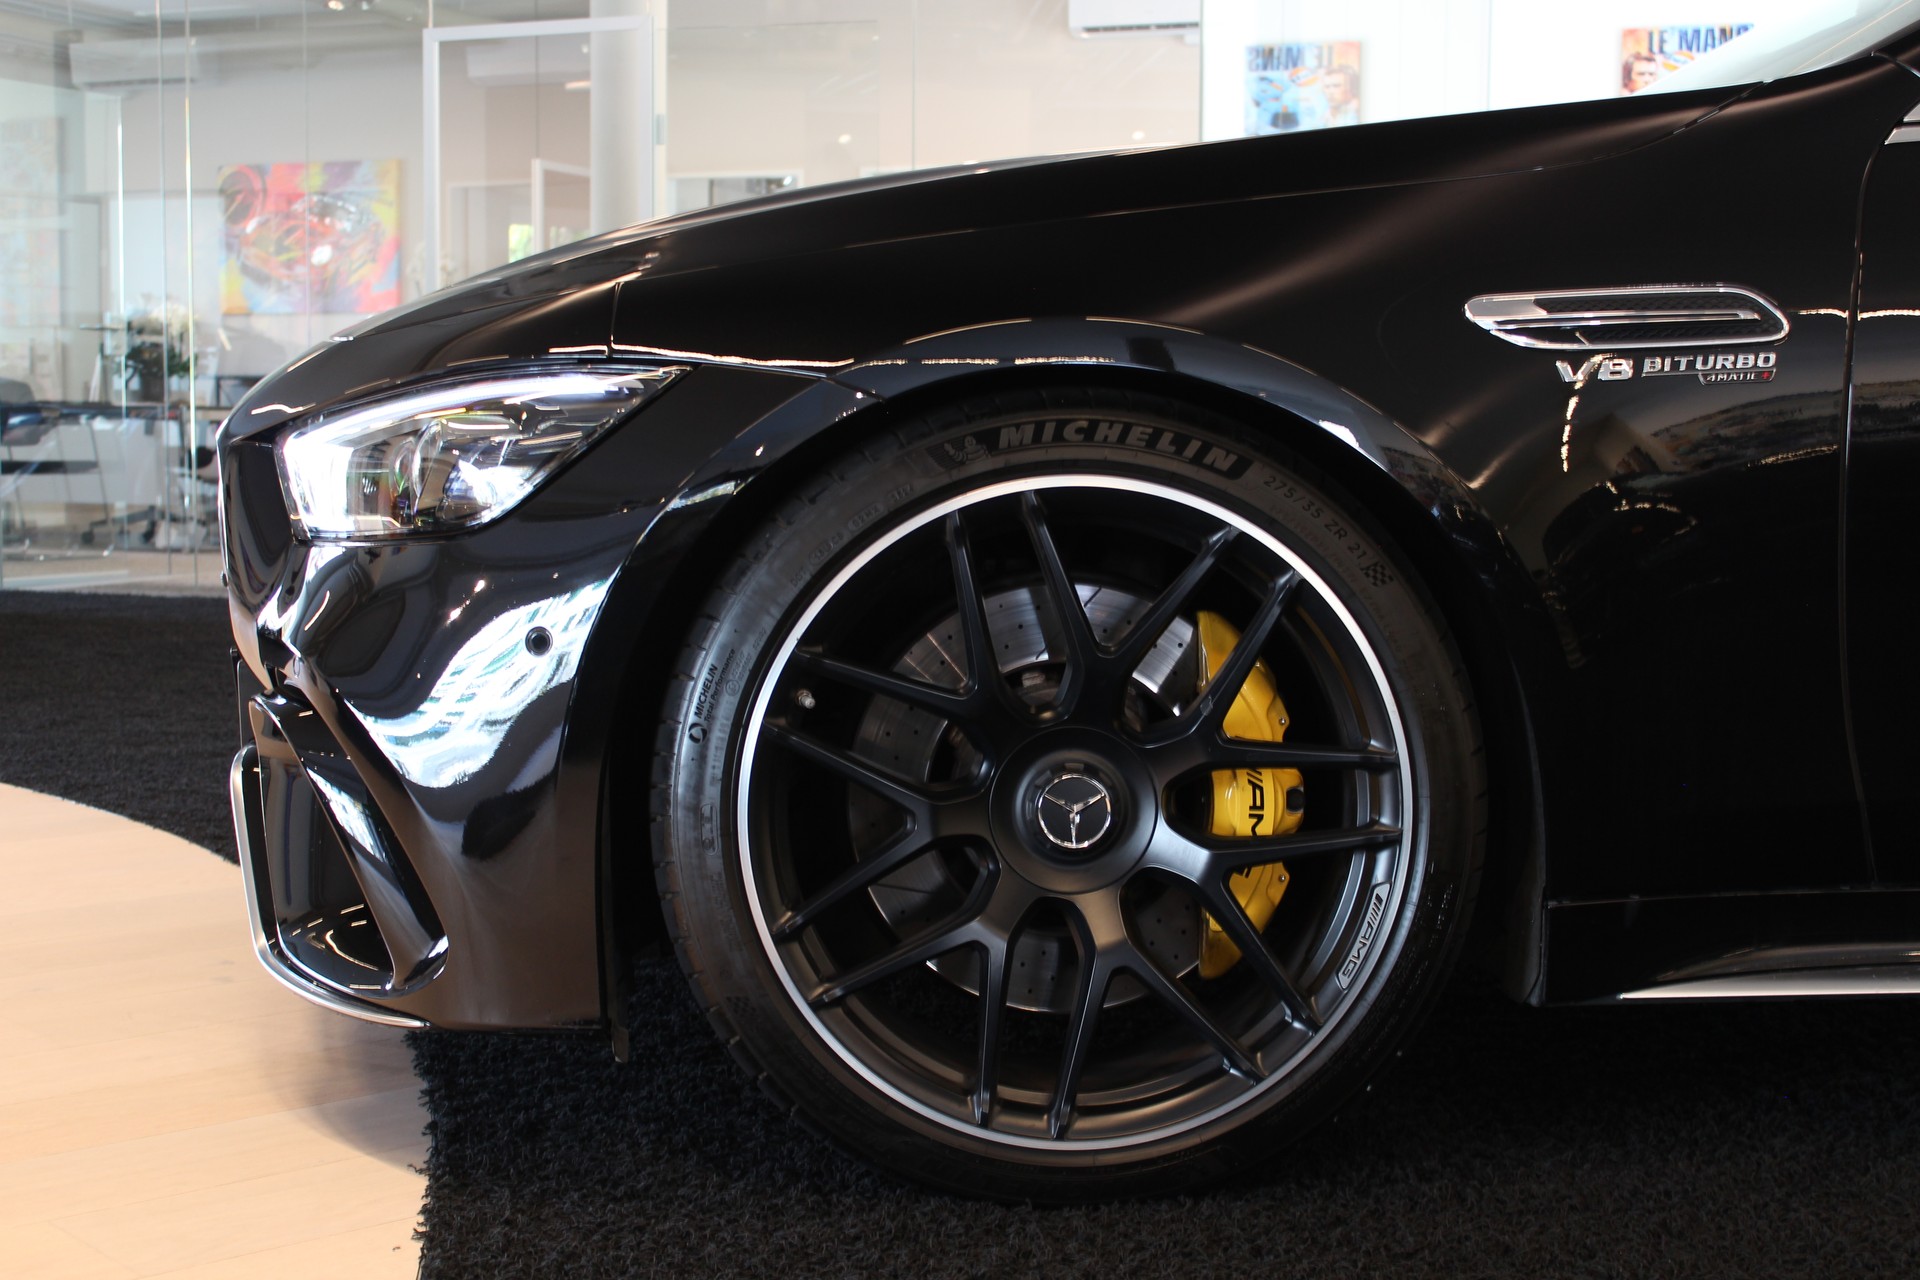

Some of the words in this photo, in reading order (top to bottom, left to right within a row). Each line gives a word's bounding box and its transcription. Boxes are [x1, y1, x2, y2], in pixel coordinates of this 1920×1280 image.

[1648, 29, 1668, 55] LE
[1555, 358, 1634, 382] V8
[1643, 352, 1776, 373] BITURBO
[998, 420, 1240, 473] MICHELIN
[1264, 476, 1325, 519] 275/35
[1325, 518, 1348, 540] ZR
[1348, 543, 1368, 560] 21
[694, 664, 718, 719] MICHELIN
[704, 703, 716, 723] Total
[711, 648, 735, 702] Performance
[1342, 921, 1374, 978] AMG
